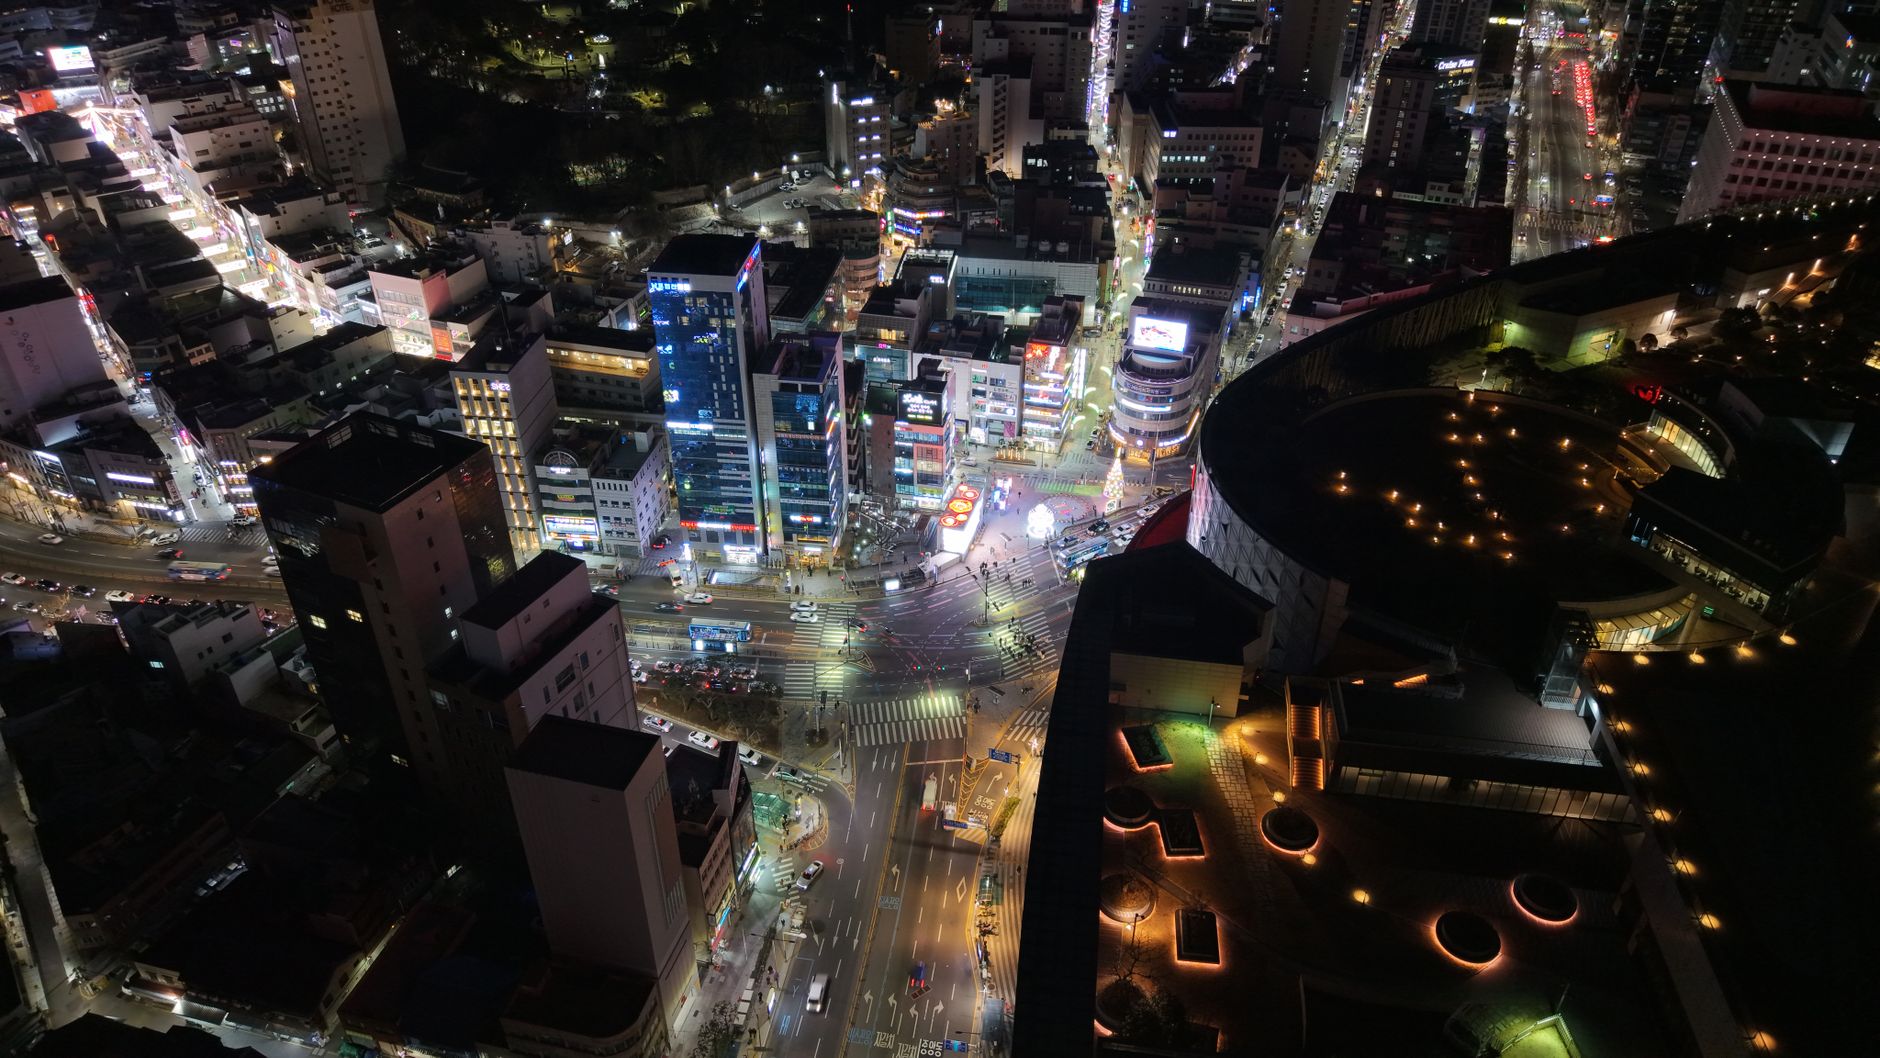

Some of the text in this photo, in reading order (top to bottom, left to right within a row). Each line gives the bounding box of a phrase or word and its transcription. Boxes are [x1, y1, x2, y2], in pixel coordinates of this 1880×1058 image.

[1438, 58, 1475, 70] Cruise Plaza
[873, 1031, 896, 1049] 자갈치
[920, 1039, 943, 1058] 중앙동
